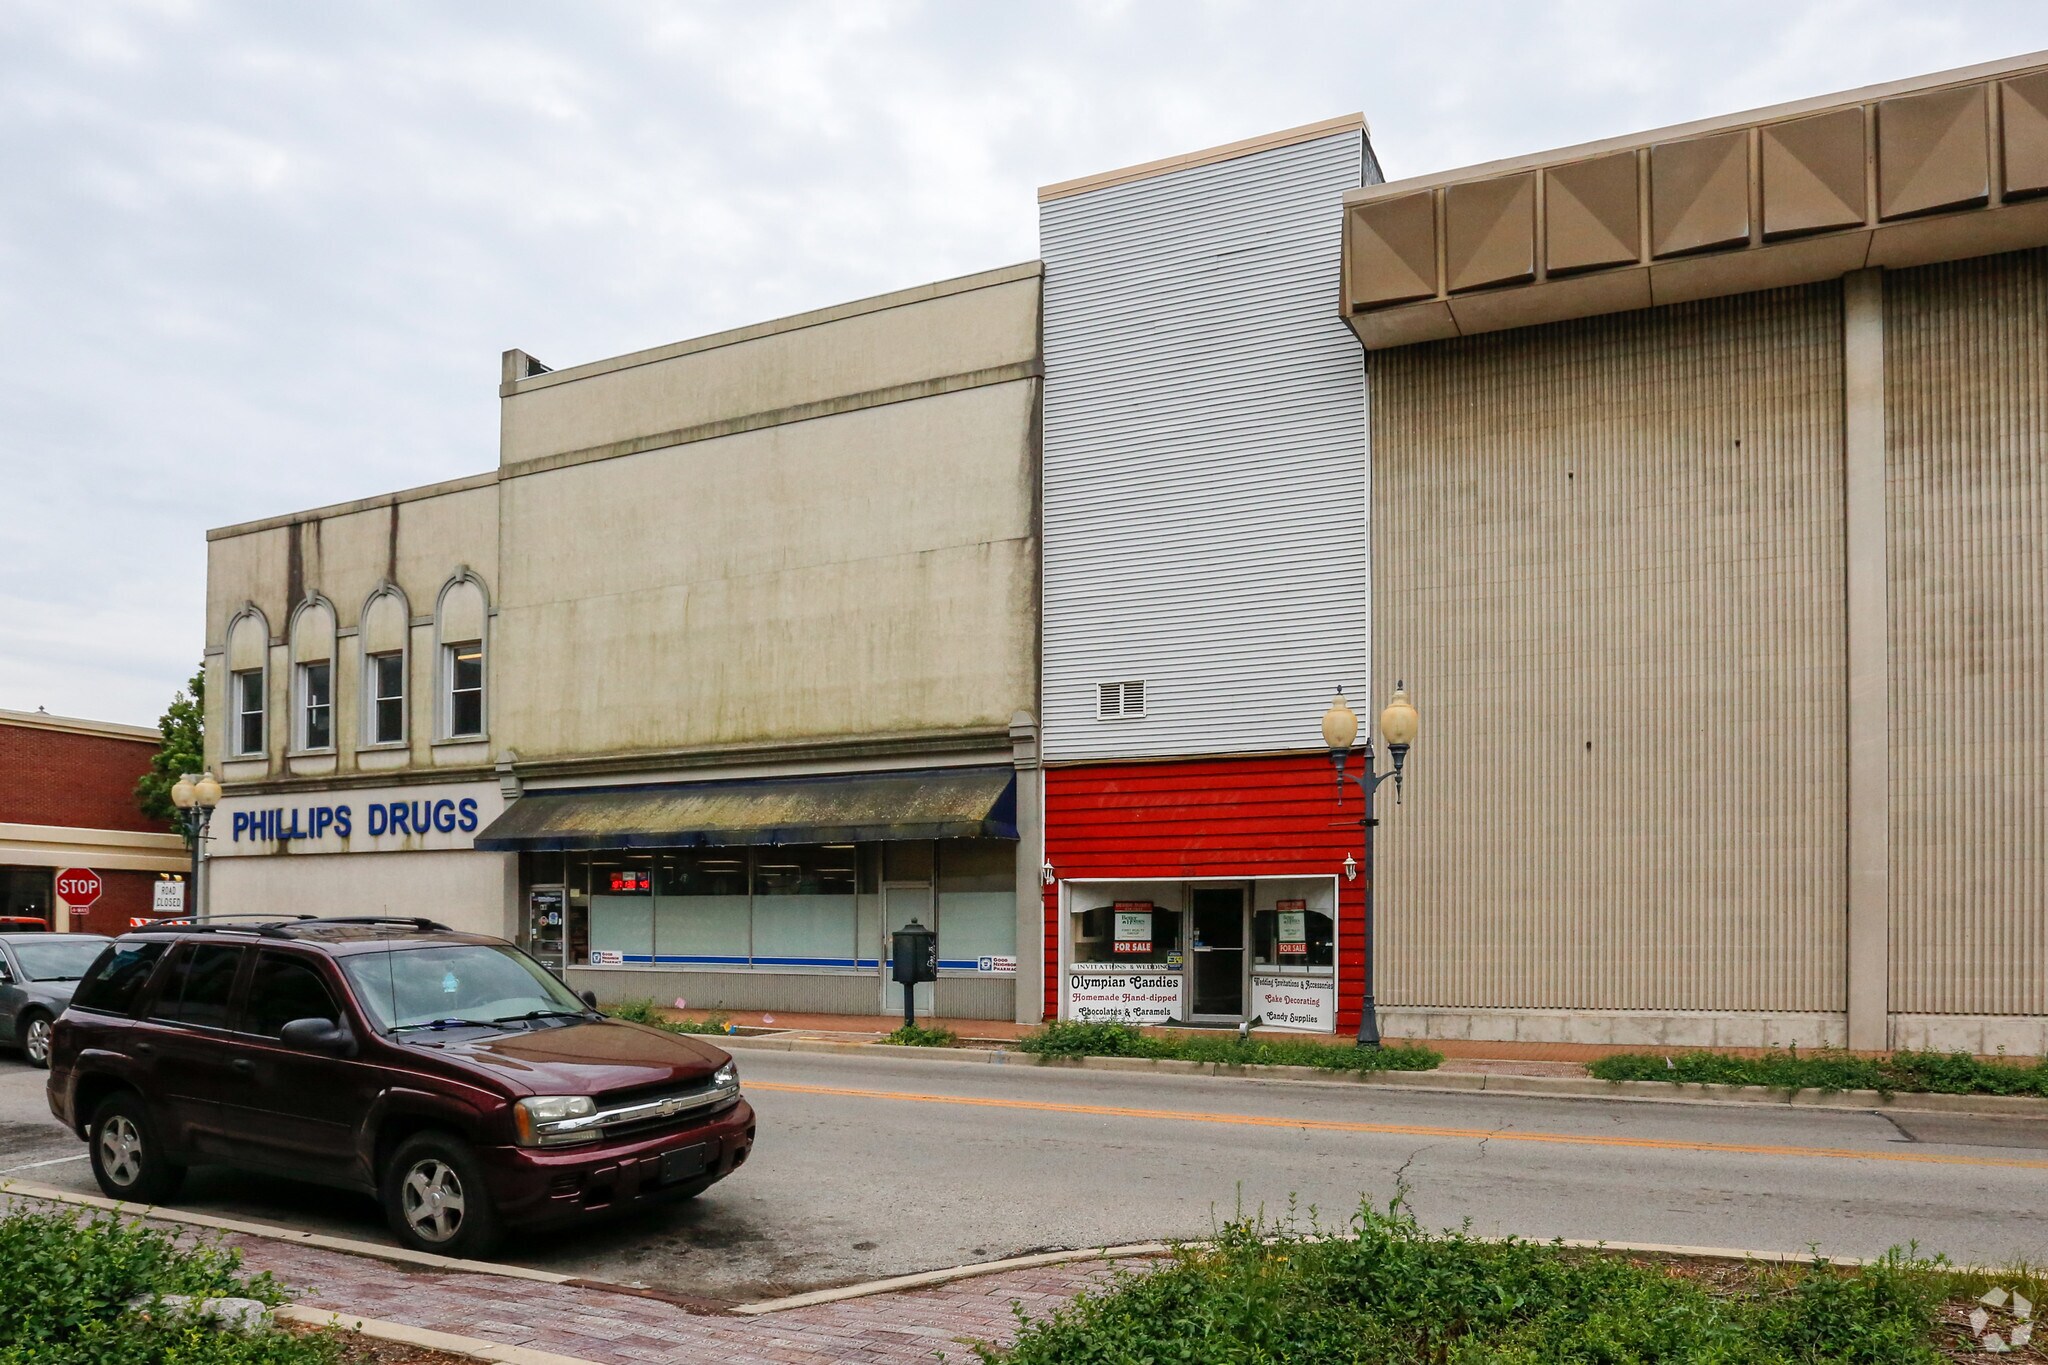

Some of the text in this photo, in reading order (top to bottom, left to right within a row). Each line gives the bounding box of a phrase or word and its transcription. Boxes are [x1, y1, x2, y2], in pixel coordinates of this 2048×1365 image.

[233, 798, 478, 842] PHILLIPS DRUGS
[60, 880, 98, 894] STOP
[161, 887, 176, 895] ROAD
[157, 898, 180, 907] CLOSED
[1114, 943, 1151, 951] FOR SALE
[1071, 975, 1179, 990] Olympian Candies
[1254, 977, 1334, 990] Wedding Invitations & Accessories
[1072, 992, 1177, 1003] Homemade Hand-dipped
[1264, 993, 1320, 1007] Cake Decorating
[1078, 1006, 1171, 1017] Chocolates & Caramels
[1267, 1011, 1318, 1023] Candy Supplies
